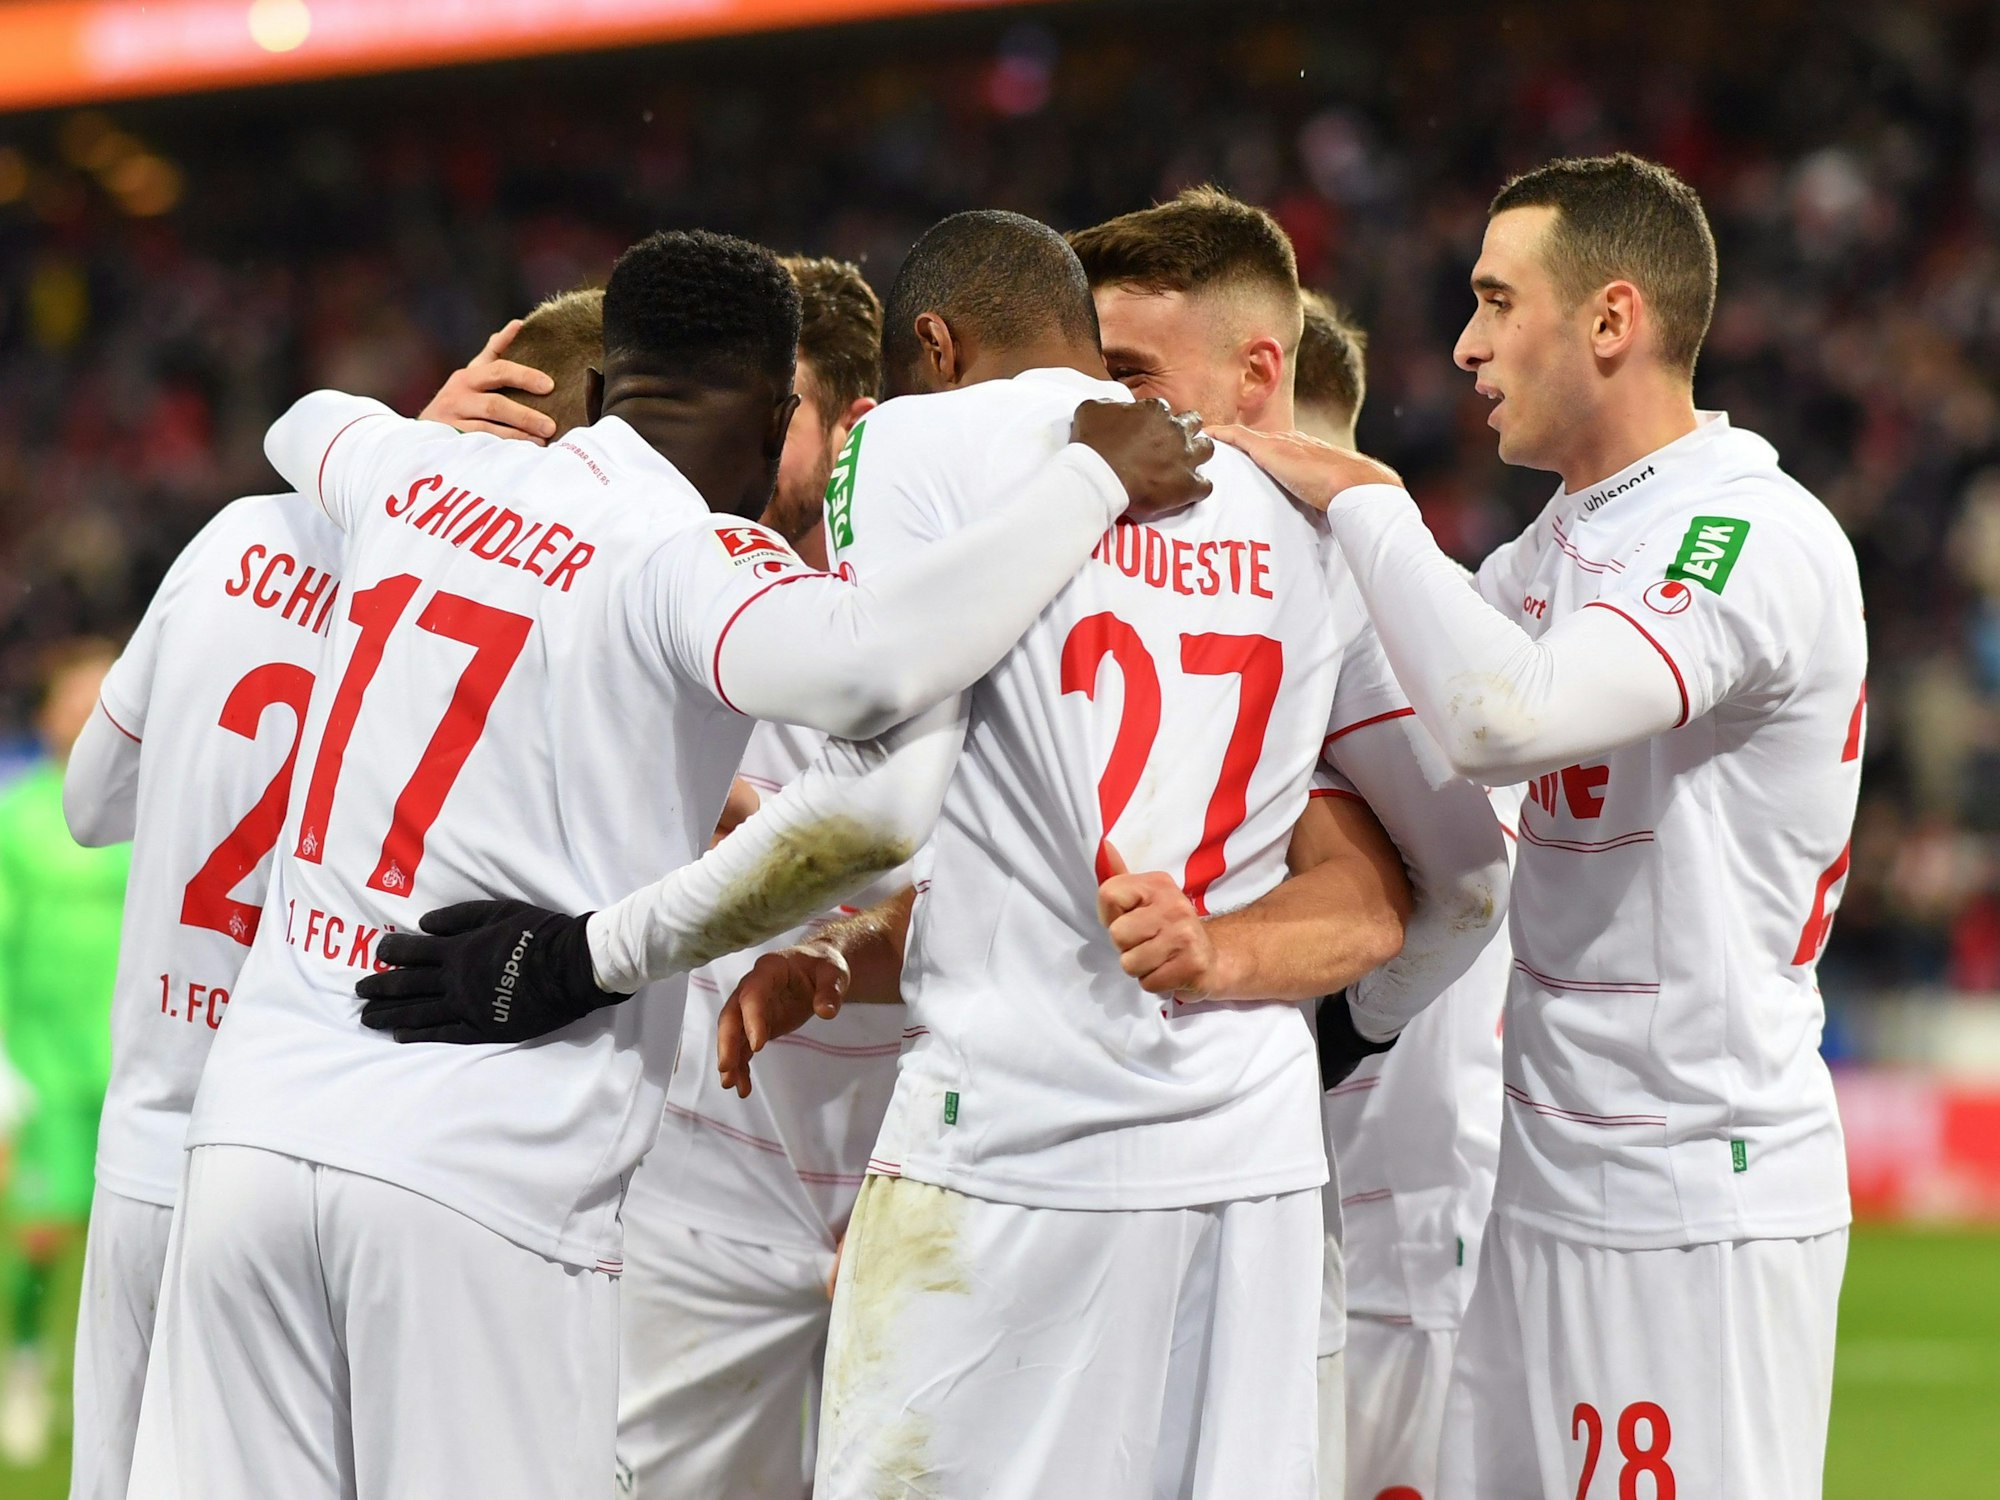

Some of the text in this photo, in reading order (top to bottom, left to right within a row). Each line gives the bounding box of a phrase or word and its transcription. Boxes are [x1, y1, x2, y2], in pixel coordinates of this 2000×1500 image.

[587, 459, 611, 486] ANDERS
[385, 473, 596, 593] SHINDLER
[1681, 524, 1735, 581] EVK
[293, 572, 535, 899] 17
[1060, 610, 1284, 917] 27
[179, 661, 317, 948] 2
[303, 908, 345, 960] FC
[491, 930, 534, 1023] uhlsport
[186, 982, 230, 1030] FC
[1571, 1401, 1676, 1500] 28
